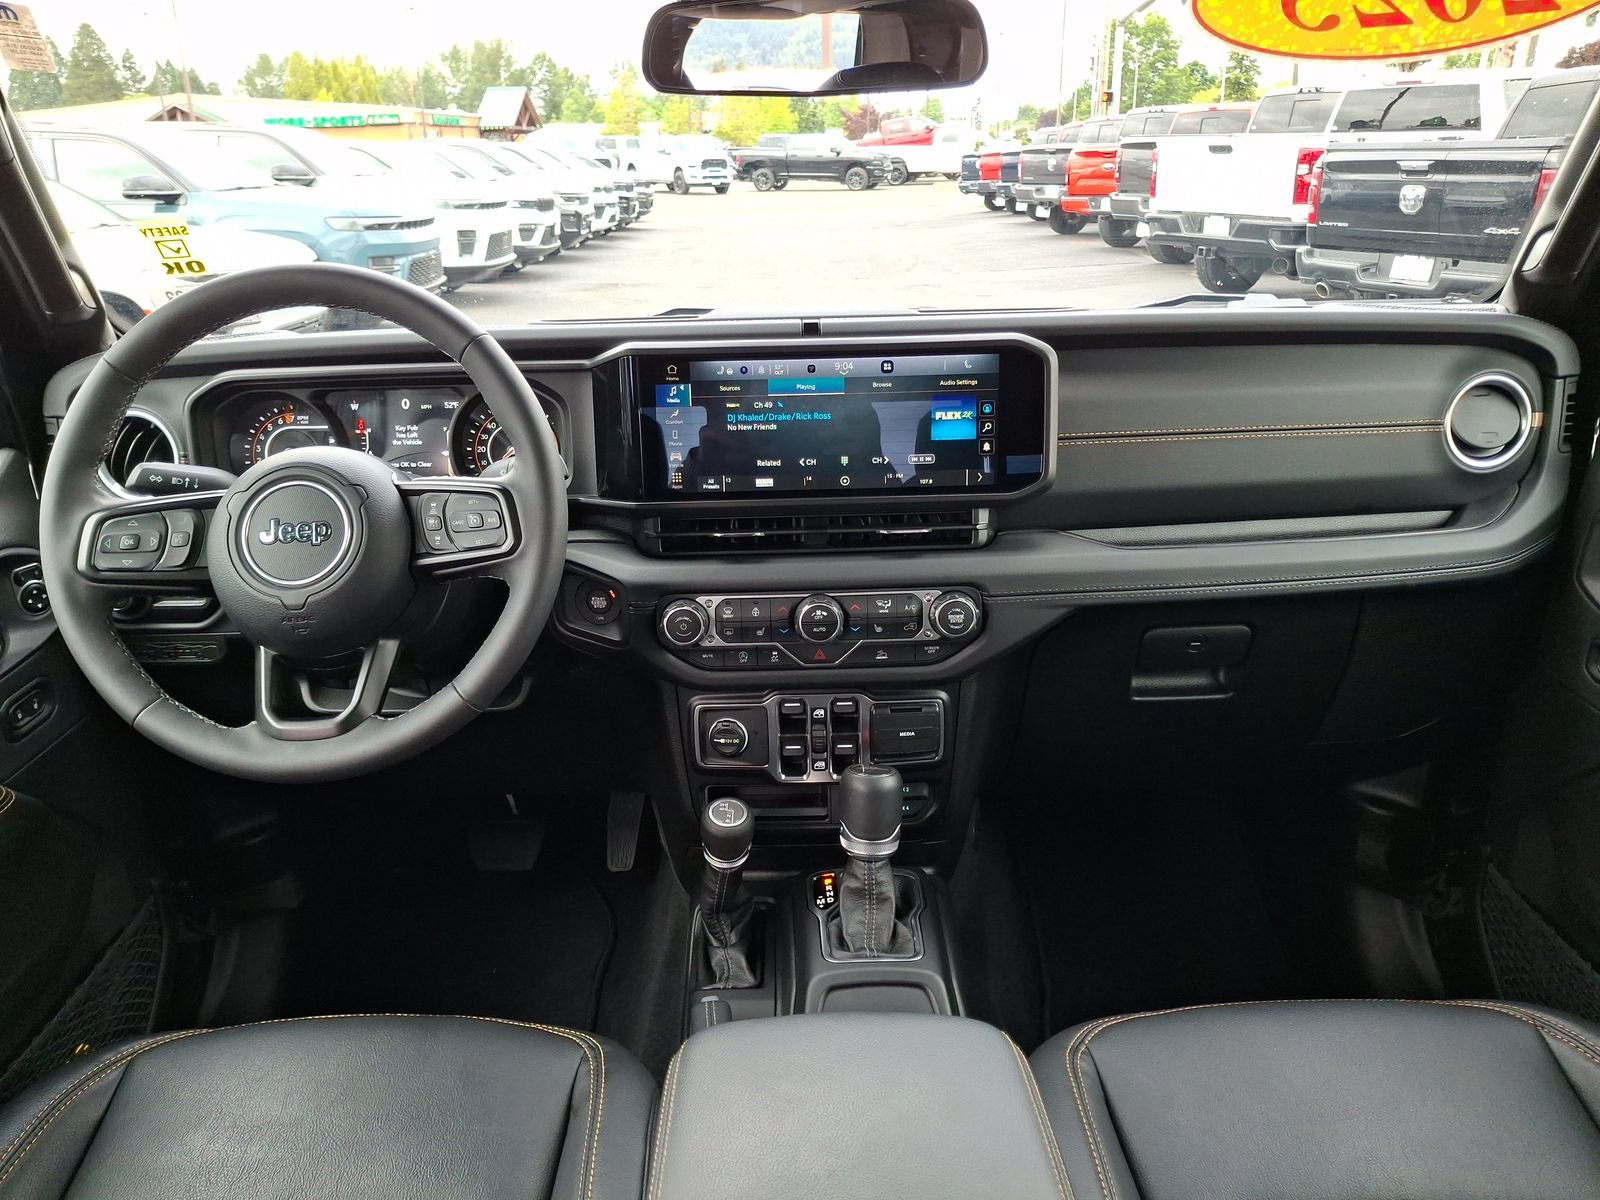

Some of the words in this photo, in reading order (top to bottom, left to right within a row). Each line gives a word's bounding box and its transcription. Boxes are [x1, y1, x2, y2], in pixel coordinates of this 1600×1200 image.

[834, 363, 853, 371] 9:04
[350, 403, 359, 411] W
[727, 414, 736, 423] DJ
[738, 412, 812, 422] Khaled/Drake/Rick
[813, 412, 832, 420] Ross
[935, 411, 962, 420] FLEX
[267, 423, 272, 431] 5
[258, 518, 332, 546] Jeep
[124, 538, 135, 546] OK
[281, 616, 316, 624] AIRBAG
